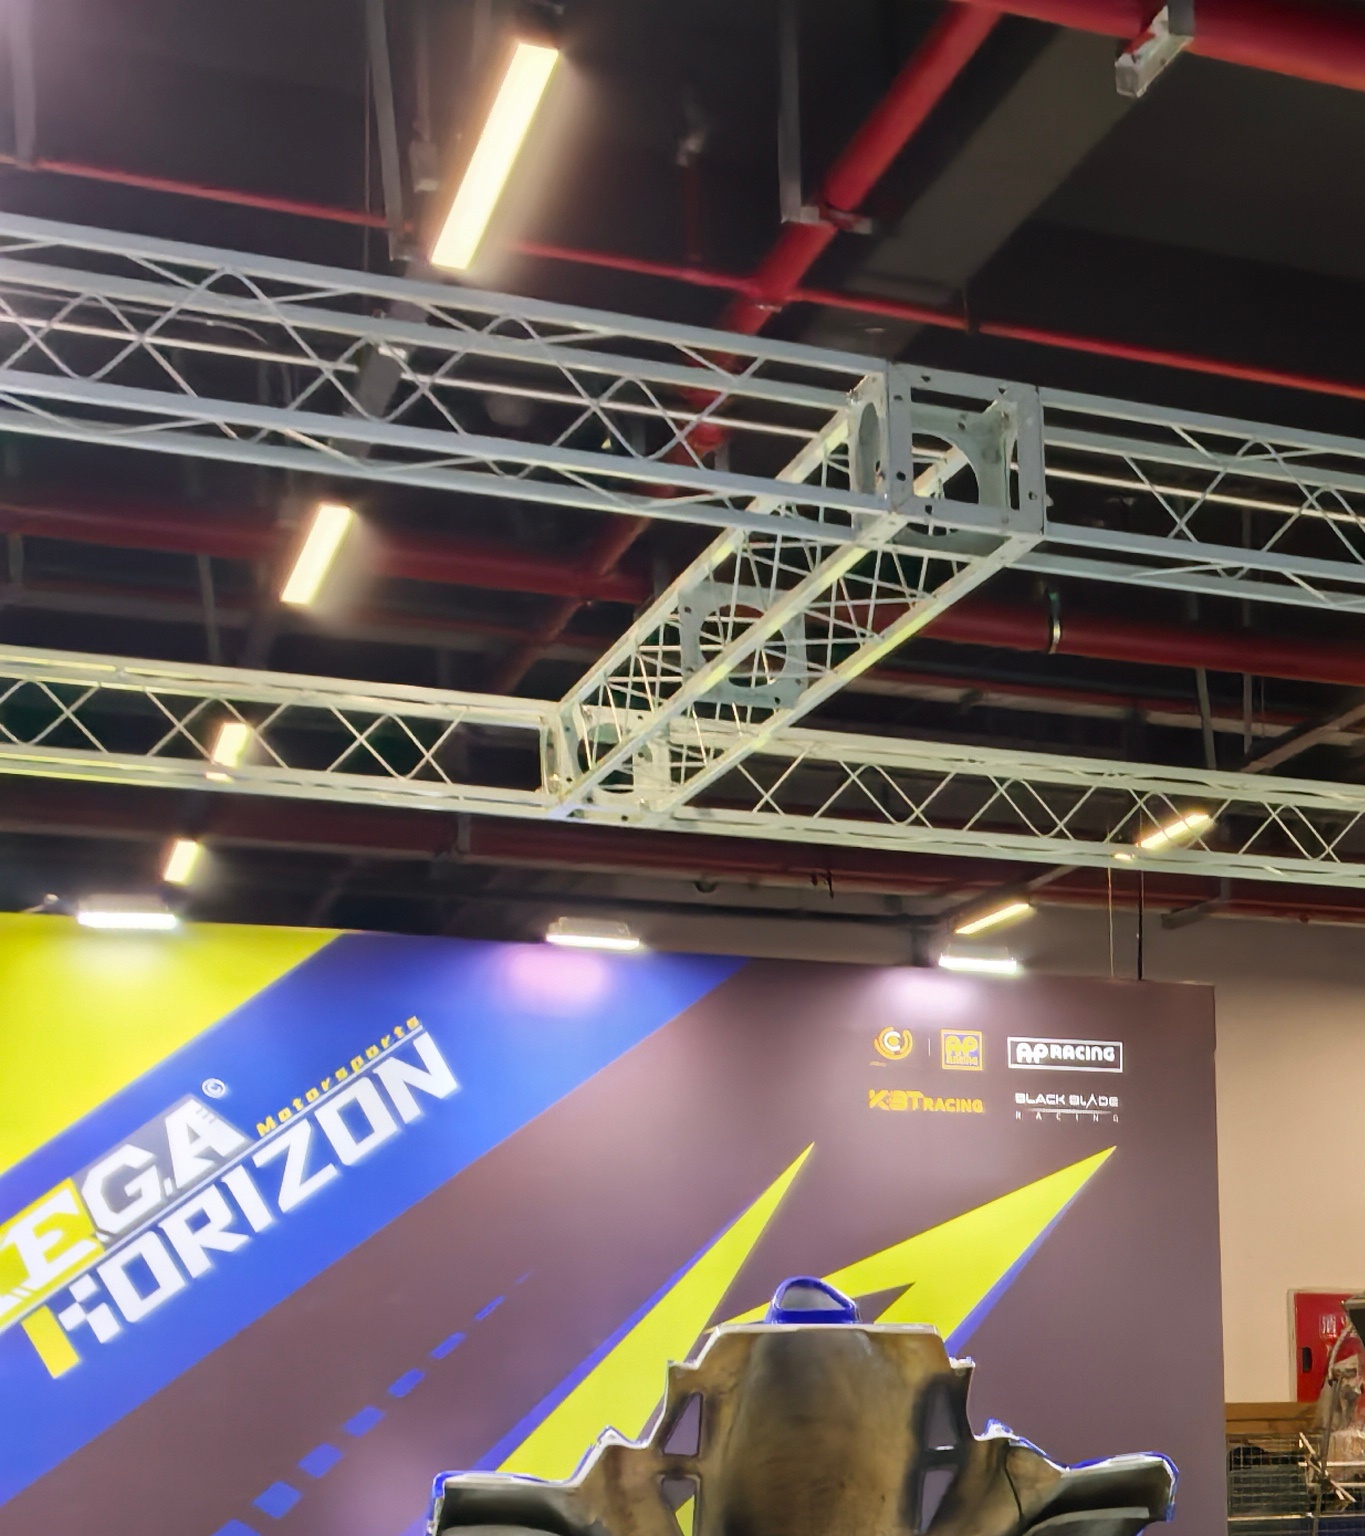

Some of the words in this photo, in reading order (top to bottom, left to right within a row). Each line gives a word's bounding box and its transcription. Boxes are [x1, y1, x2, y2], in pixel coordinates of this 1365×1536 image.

[256, 1015, 424, 1137] Motorsports
[1015, 1092, 1066, 1106] BLACK
[1069, 1093, 1119, 1109] BLADE
[1016, 1042, 1049, 1064] AP
[1050, 1044, 1115, 1062] RACING
[0, 1096, 249, 1317] EGA
[20, 1032, 460, 1379] HORIZON
